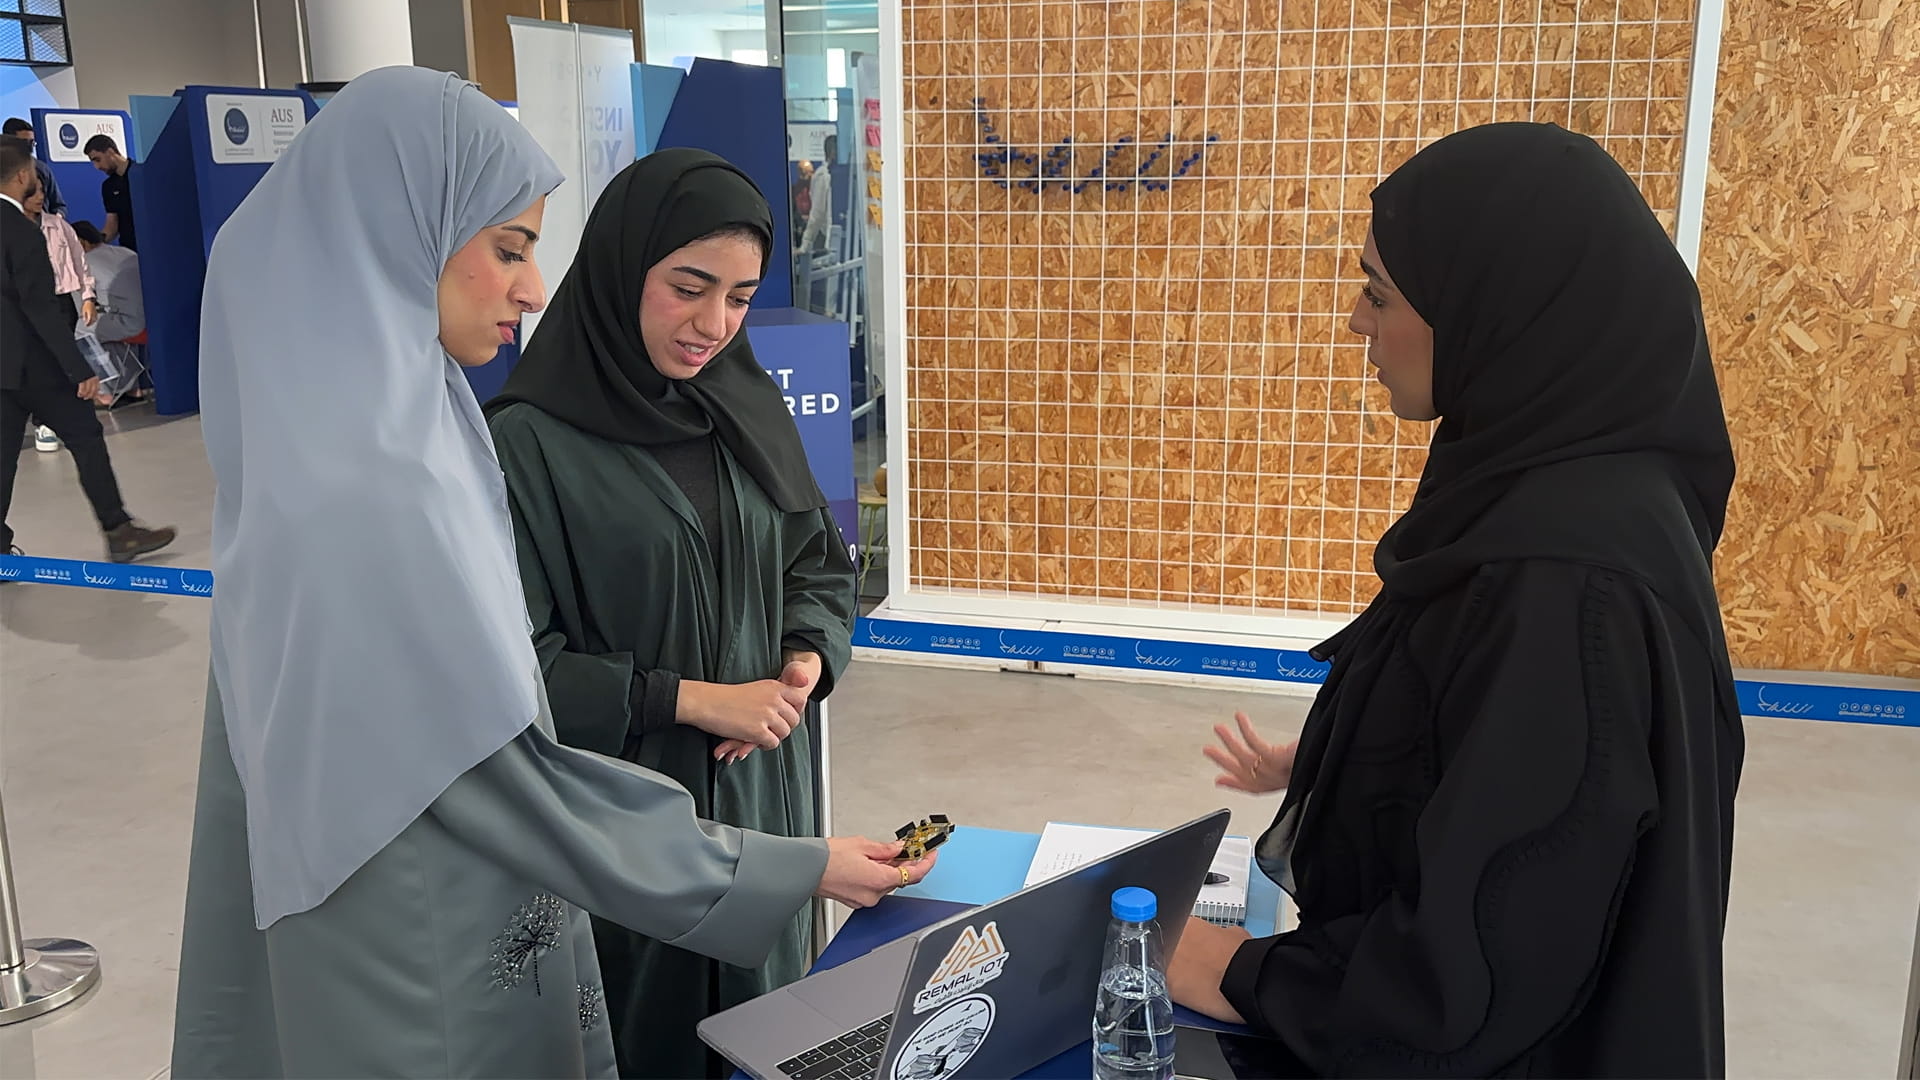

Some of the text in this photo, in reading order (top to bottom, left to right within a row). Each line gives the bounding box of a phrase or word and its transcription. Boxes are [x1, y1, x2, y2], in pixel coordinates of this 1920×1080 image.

[271, 108, 294, 123] AUS
[96, 123, 115, 134] AUS
[918, 972, 976, 1004] REMAL
[979, 955, 1007, 976] IOT
